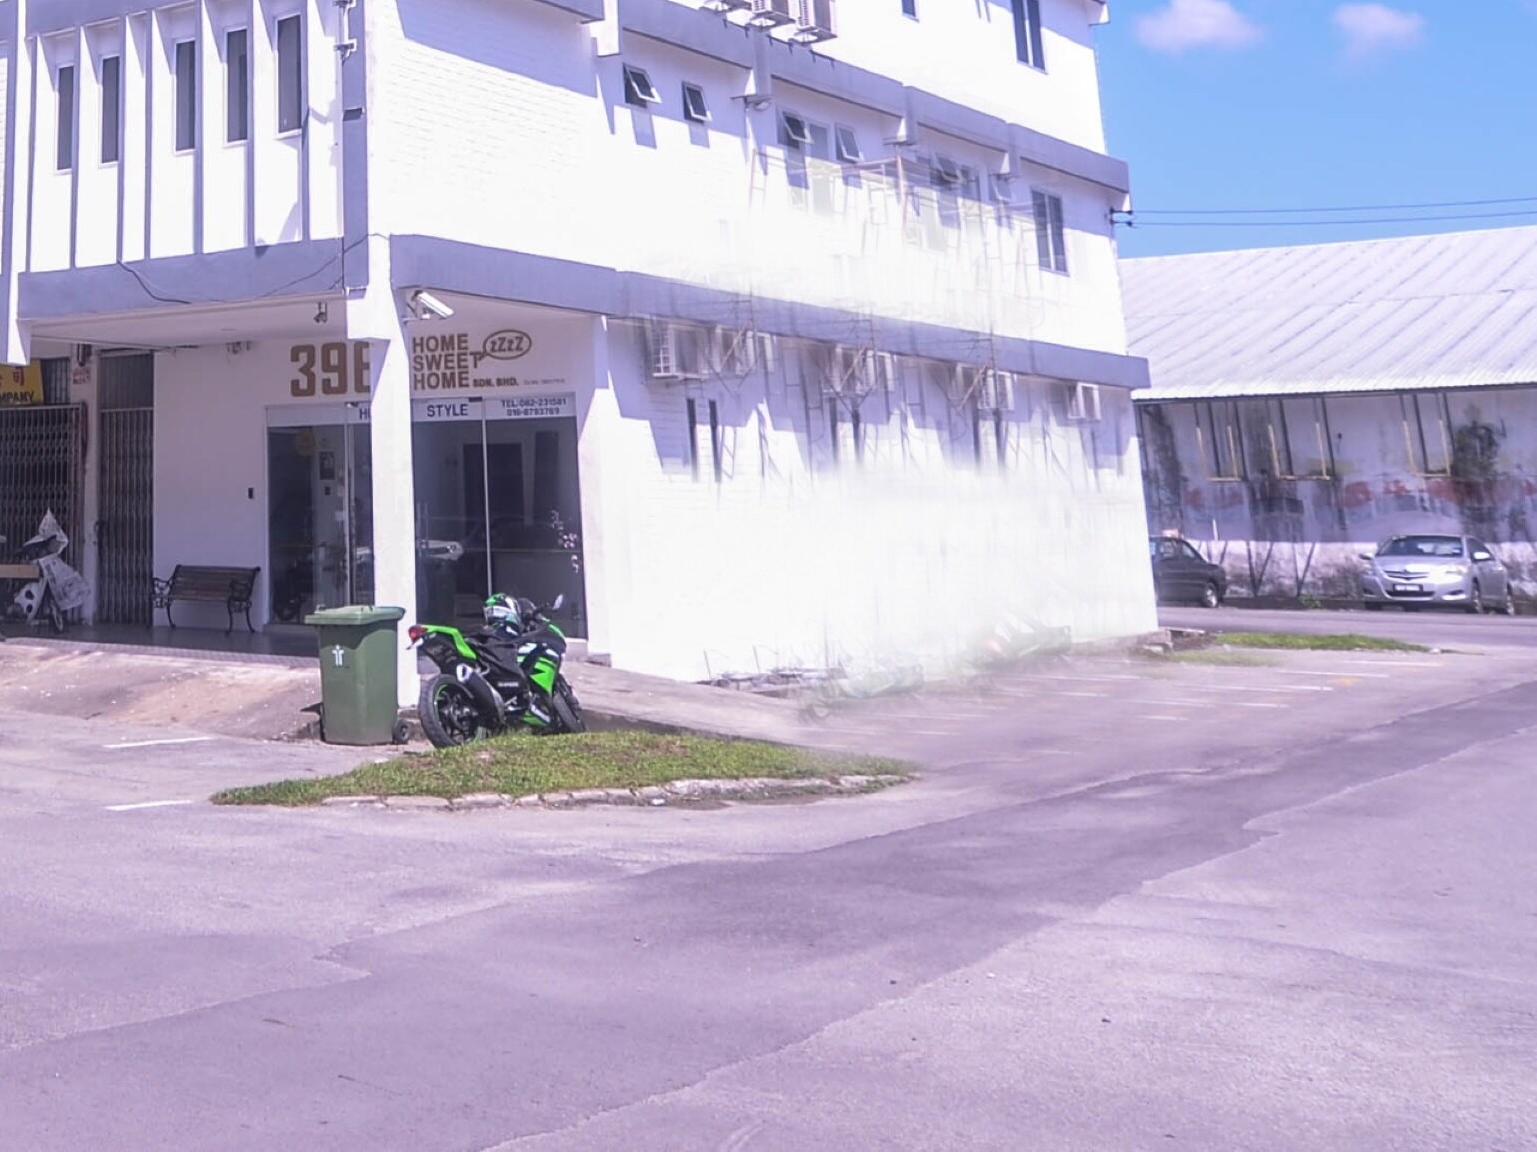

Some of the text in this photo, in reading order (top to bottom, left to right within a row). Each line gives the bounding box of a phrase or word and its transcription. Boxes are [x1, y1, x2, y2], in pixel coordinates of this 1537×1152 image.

[412, 333, 469, 354] HOME
[412, 351, 482, 373] SWEET
[413, 371, 470, 391] HOME
[426, 403, 469, 418] STYLE
